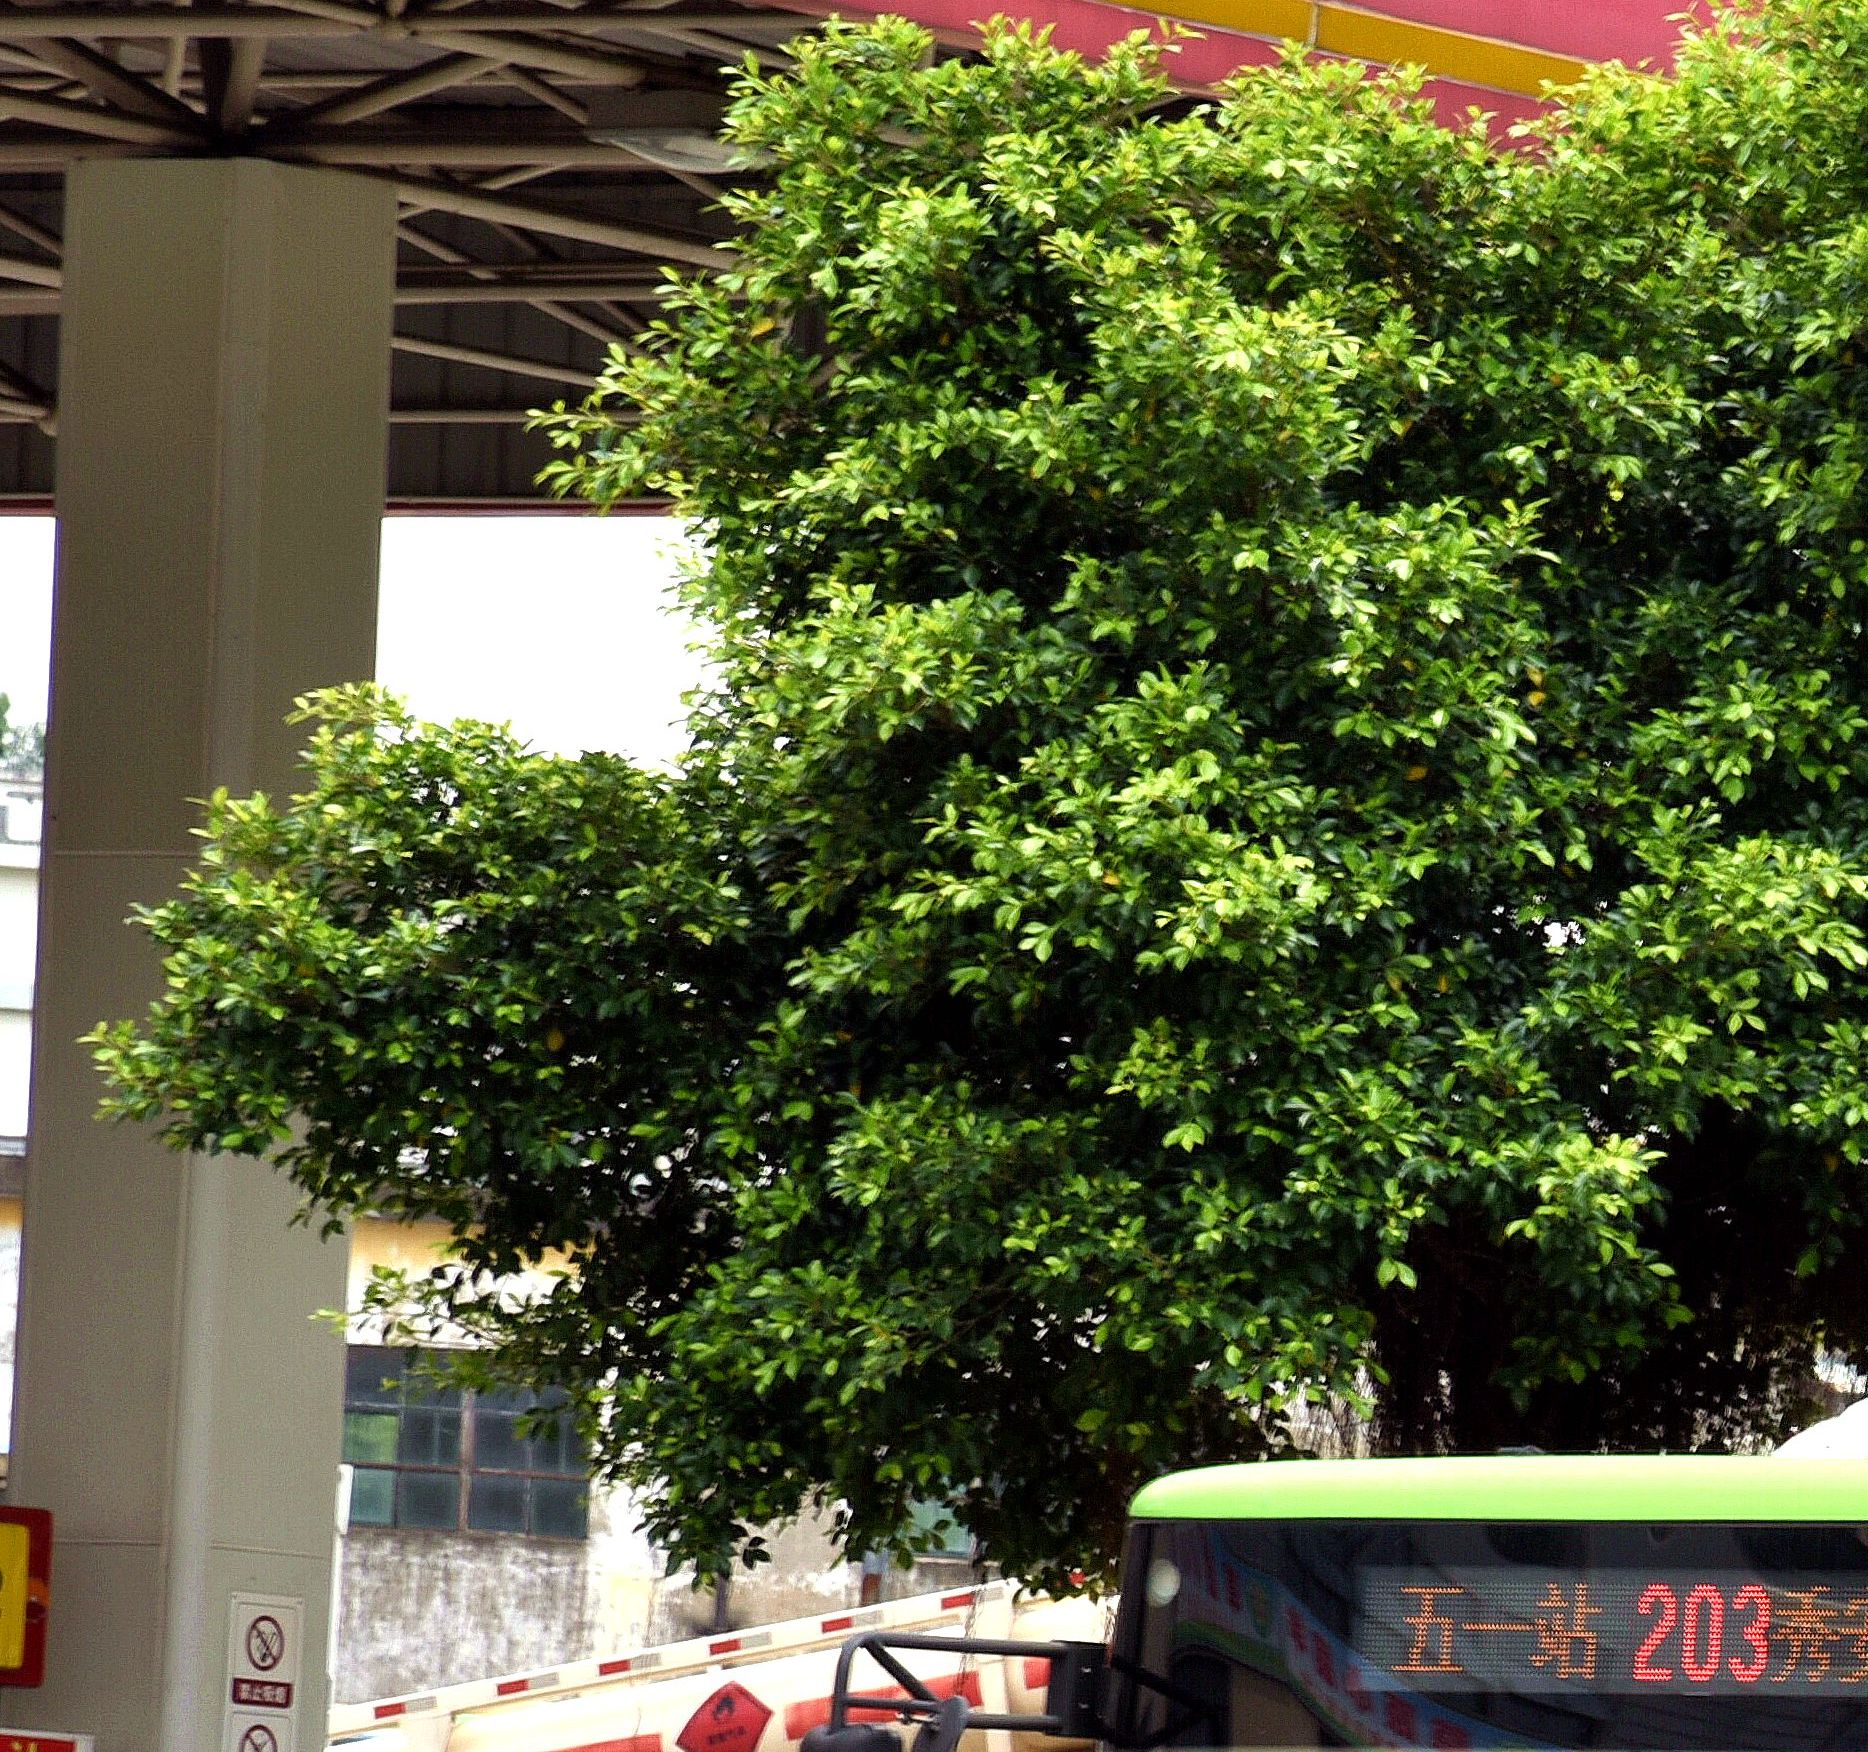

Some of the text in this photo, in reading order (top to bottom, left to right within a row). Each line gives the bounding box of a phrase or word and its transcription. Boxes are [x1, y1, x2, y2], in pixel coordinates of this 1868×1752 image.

[1391, 1583, 1603, 1679] 五一站
[1633, 1583, 1771, 1681] 203
